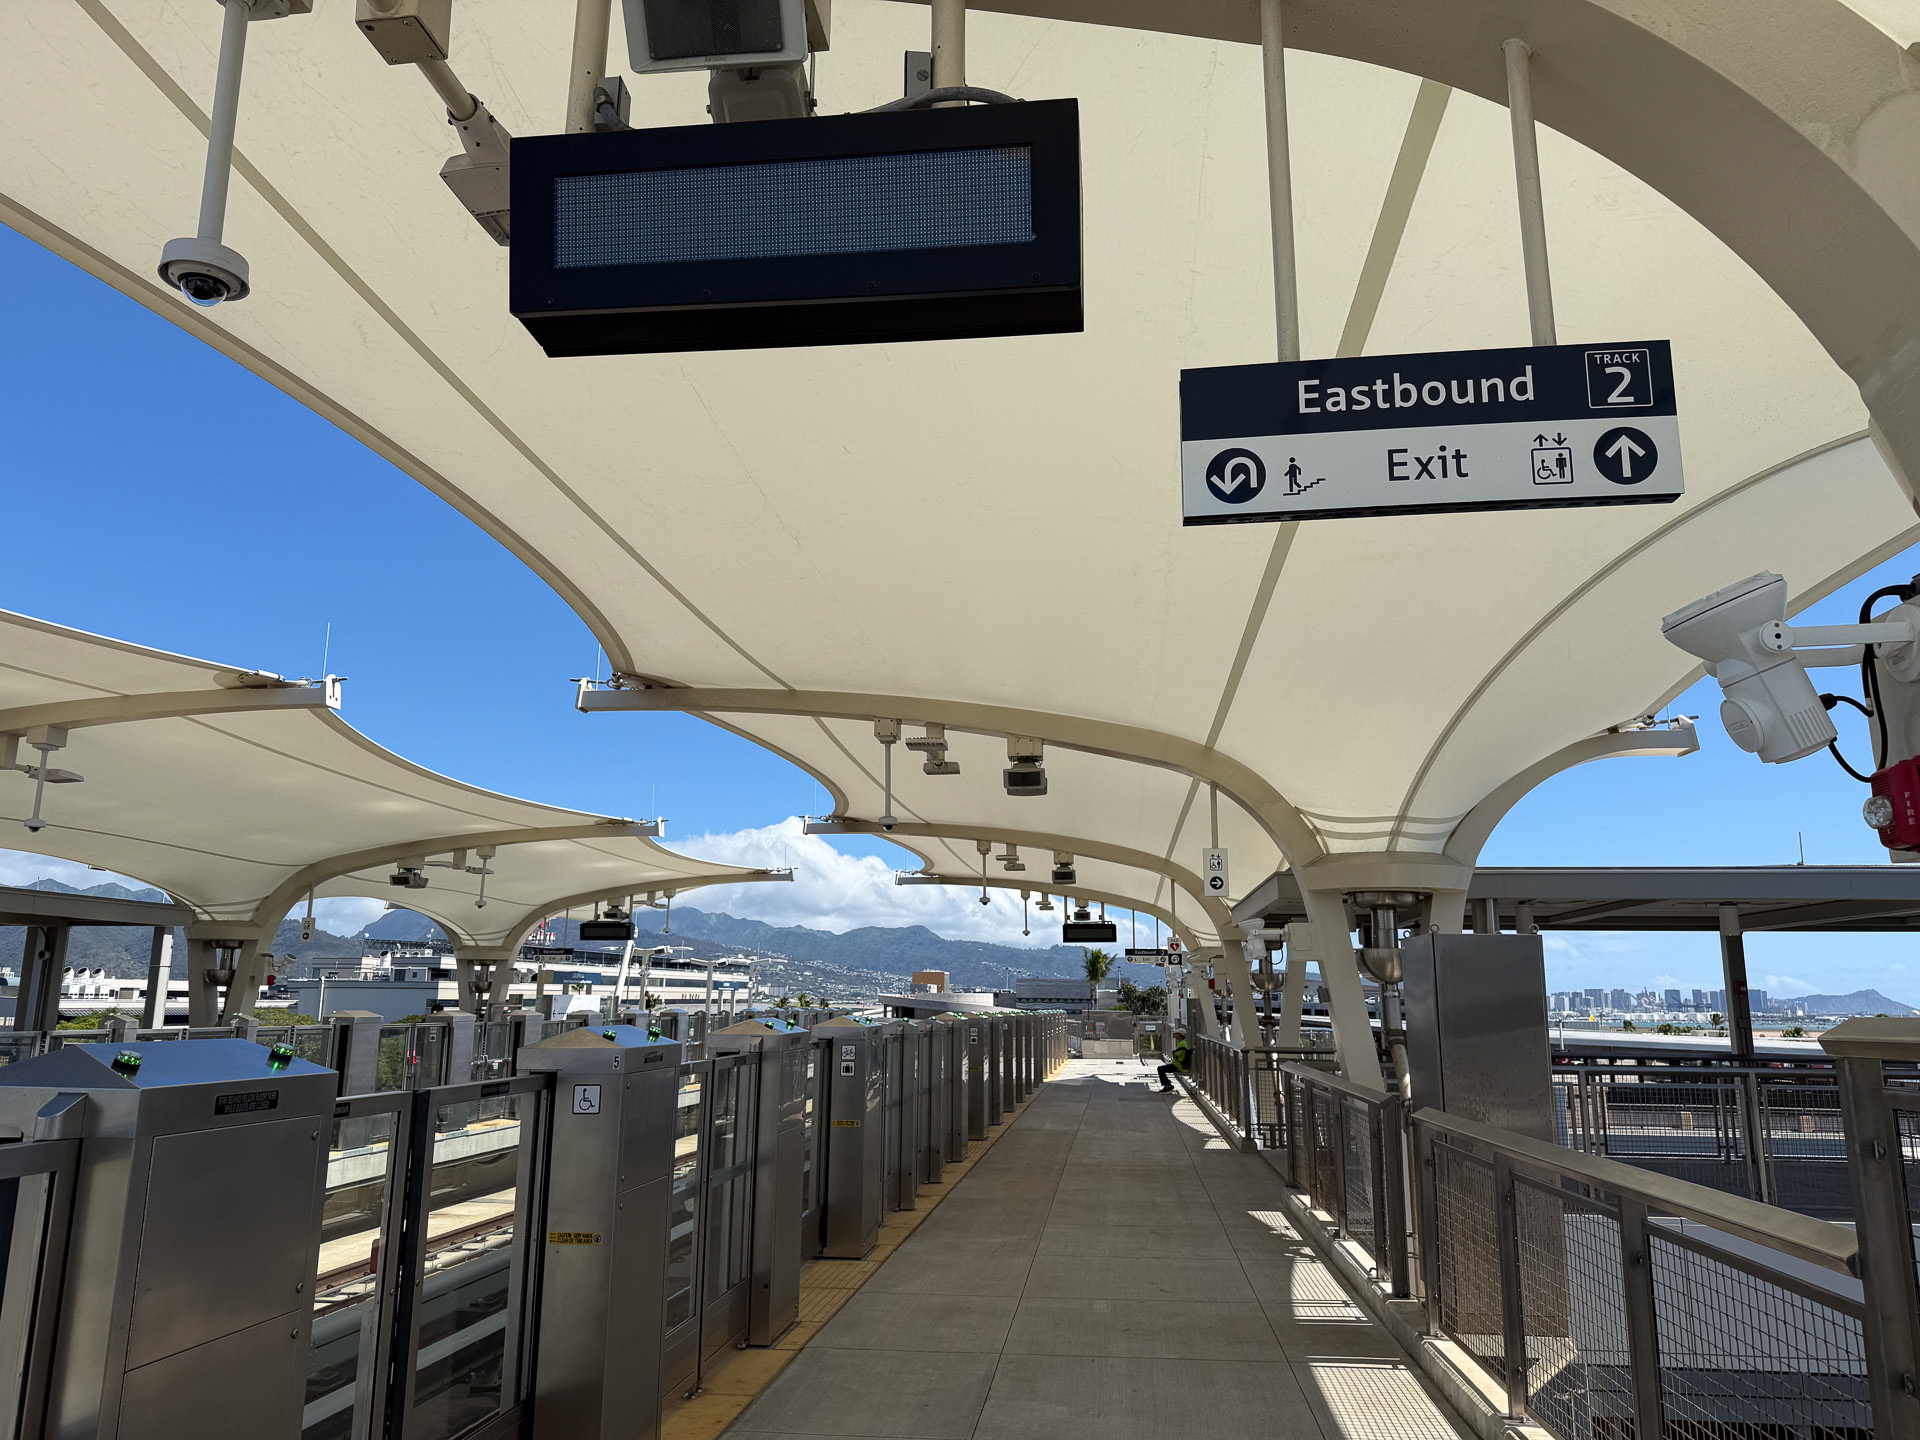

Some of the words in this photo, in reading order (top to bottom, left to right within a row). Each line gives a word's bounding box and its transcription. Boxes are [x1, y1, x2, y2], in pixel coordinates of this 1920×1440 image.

[1594, 353, 1640, 364] TRACK
[1298, 365, 1535, 413] Eastbound
[1604, 366, 1635, 403] 2
[1387, 445, 1469, 481] Exit
[1904, 791, 1916, 825] FIRE
[613, 1056, 620, 1069] 5
[218, 1096, 228, 1105] STAY
[228, 1095, 241, 1104] BEHIND
[242, 1094, 256, 1103] YELLOW
[256, 1092, 267, 1101] FLOOR
[268, 1091, 277, 1100] TILES
[224, 1104, 236, 1113] WHILE
[236, 1103, 248, 1112] DOORS
[256, 1101, 270, 1109] CLOSED
